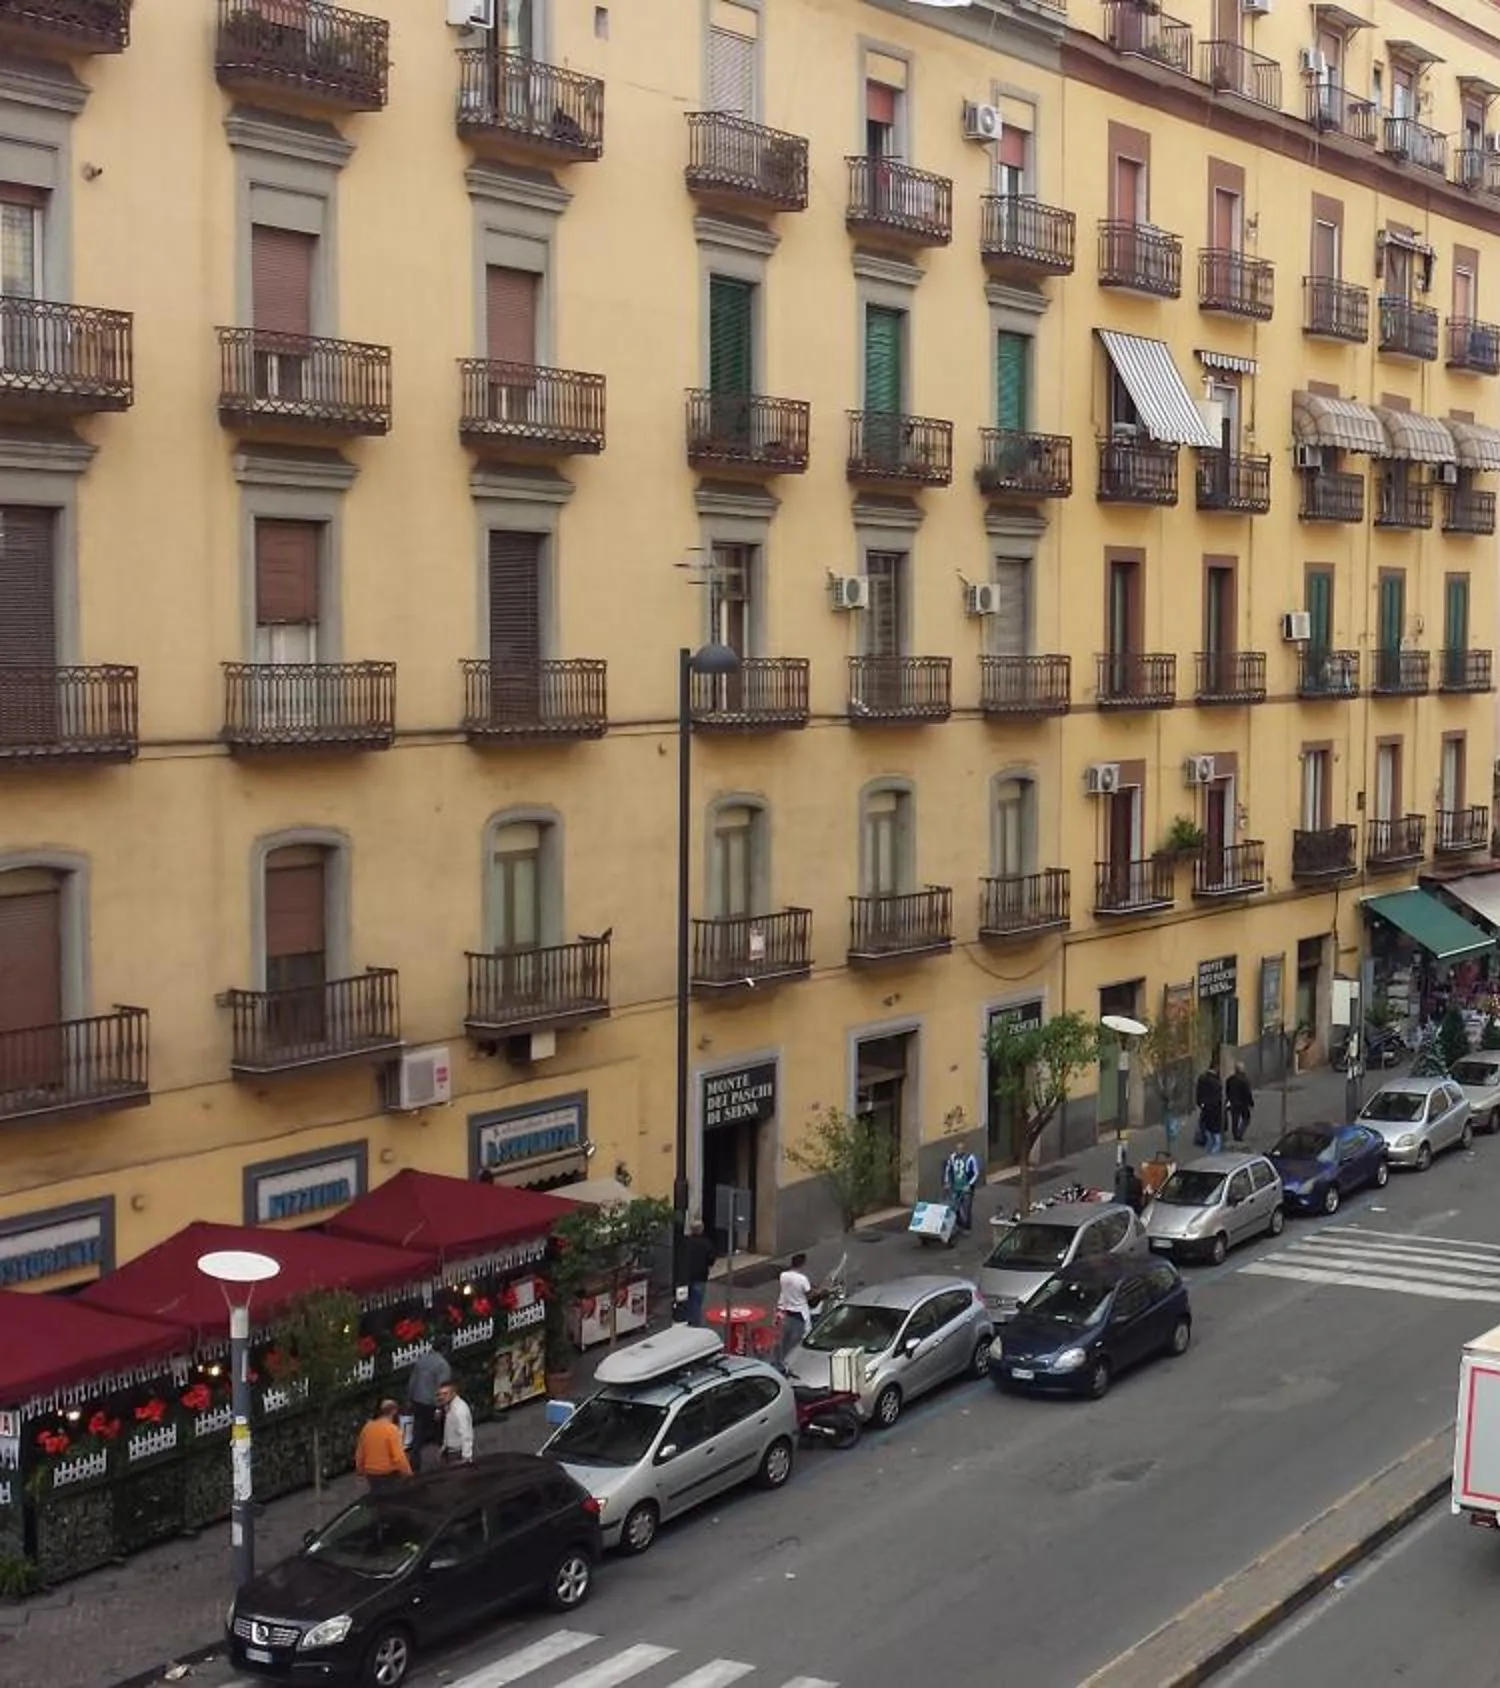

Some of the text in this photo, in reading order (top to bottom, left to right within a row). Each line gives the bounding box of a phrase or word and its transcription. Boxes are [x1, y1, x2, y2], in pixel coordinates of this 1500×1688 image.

[706, 1073, 751, 1096] MONTE
[707, 1083, 773, 1111] DEI PASCHI
[707, 1101, 759, 1125] DI SIENA
